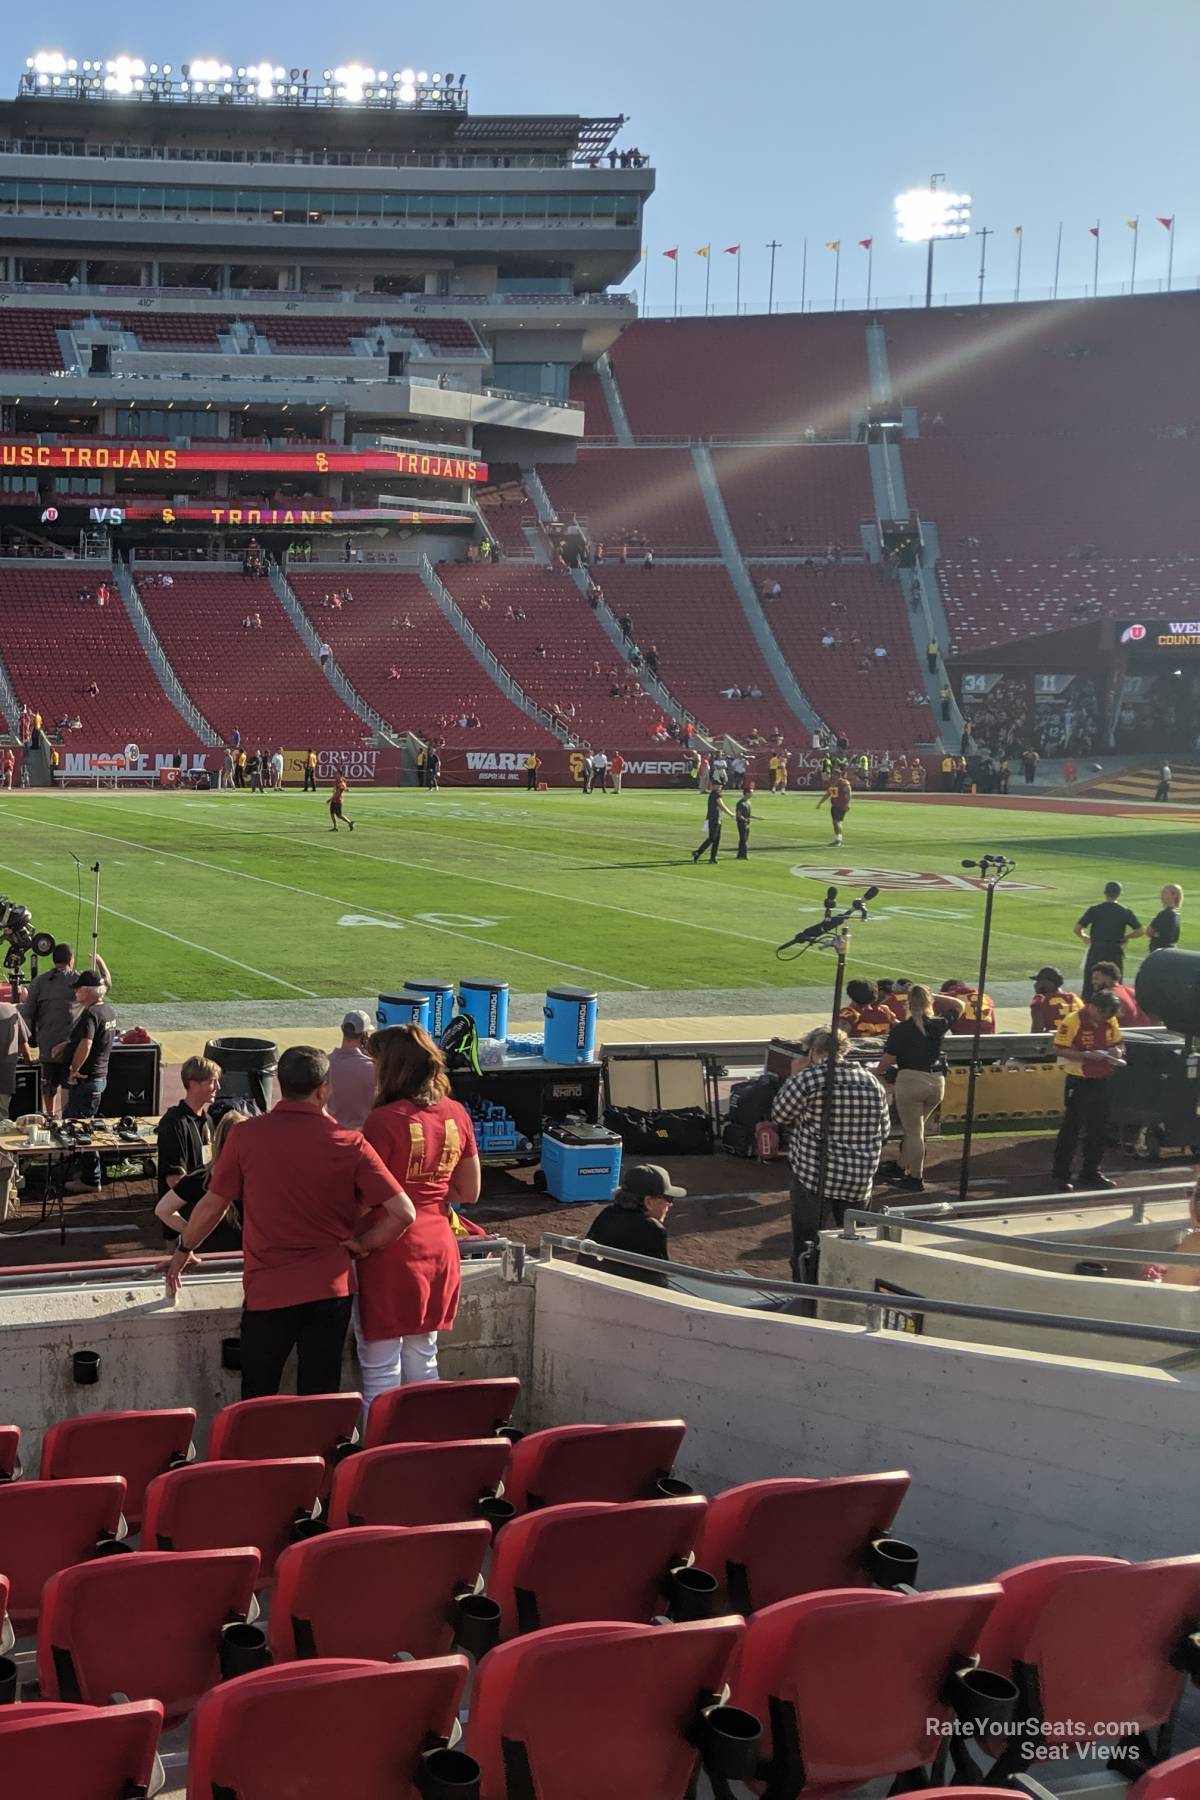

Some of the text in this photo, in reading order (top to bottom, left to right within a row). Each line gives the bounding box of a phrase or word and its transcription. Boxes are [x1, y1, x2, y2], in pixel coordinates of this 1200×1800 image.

[2, 446, 178, 470] USC TROJANS
[397, 452, 478, 480] TROJANS
[93, 507, 122, 525] VS
[965, 675, 986, 691] 34
[1041, 676, 1056, 691] 11
[317, 751, 380, 764] CREDIT
[318, 765, 376, 778] UNION
[435, 993, 443, 1038] POWERADE
[489, 993, 497, 1037] POWERADE
[577, 1003, 587, 1048] POWERADE
[579, 1167, 609, 1175] POWERADE
